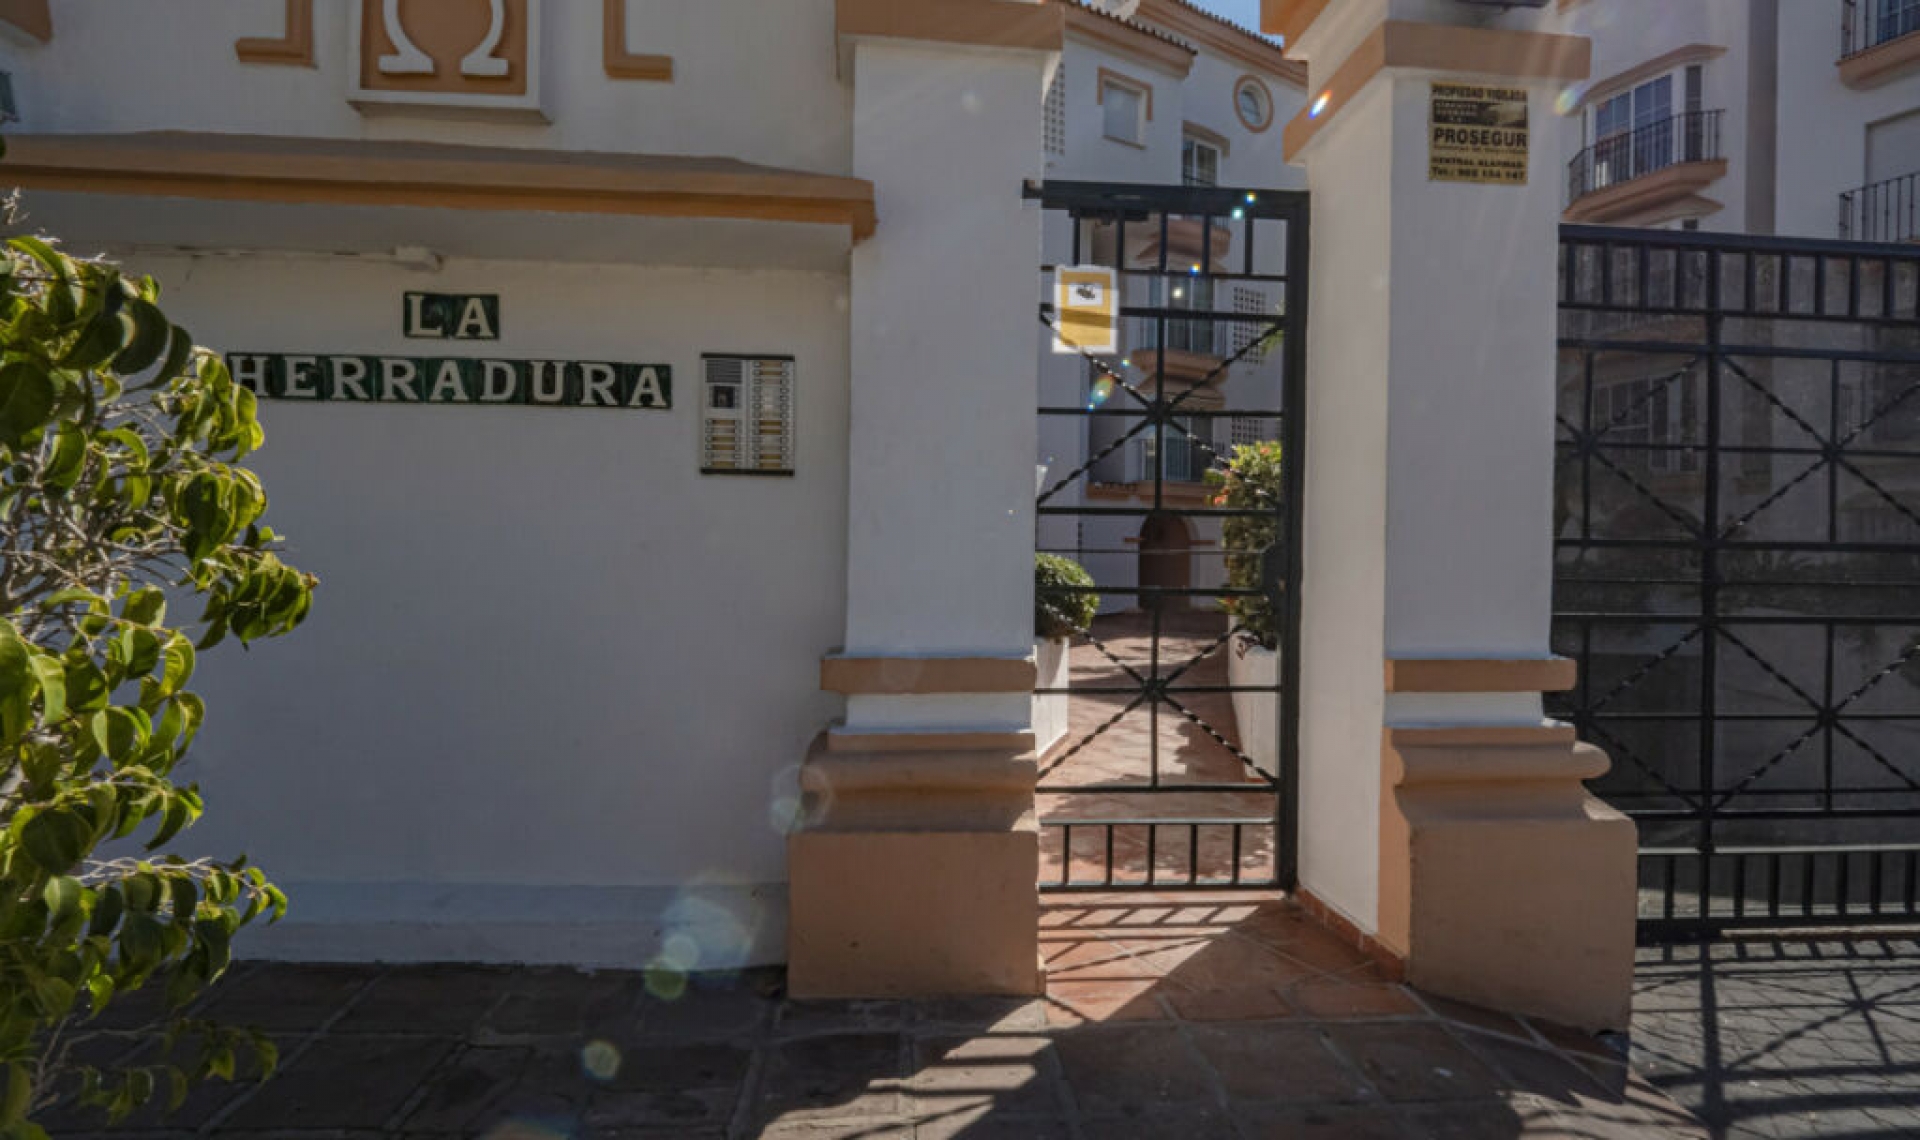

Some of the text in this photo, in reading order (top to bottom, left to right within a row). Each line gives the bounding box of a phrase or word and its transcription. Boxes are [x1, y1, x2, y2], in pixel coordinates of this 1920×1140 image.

[1433, 128, 1527, 147] PROSEGUR
[409, 294, 495, 338] LA
[230, 354, 667, 408] HERRADURA
